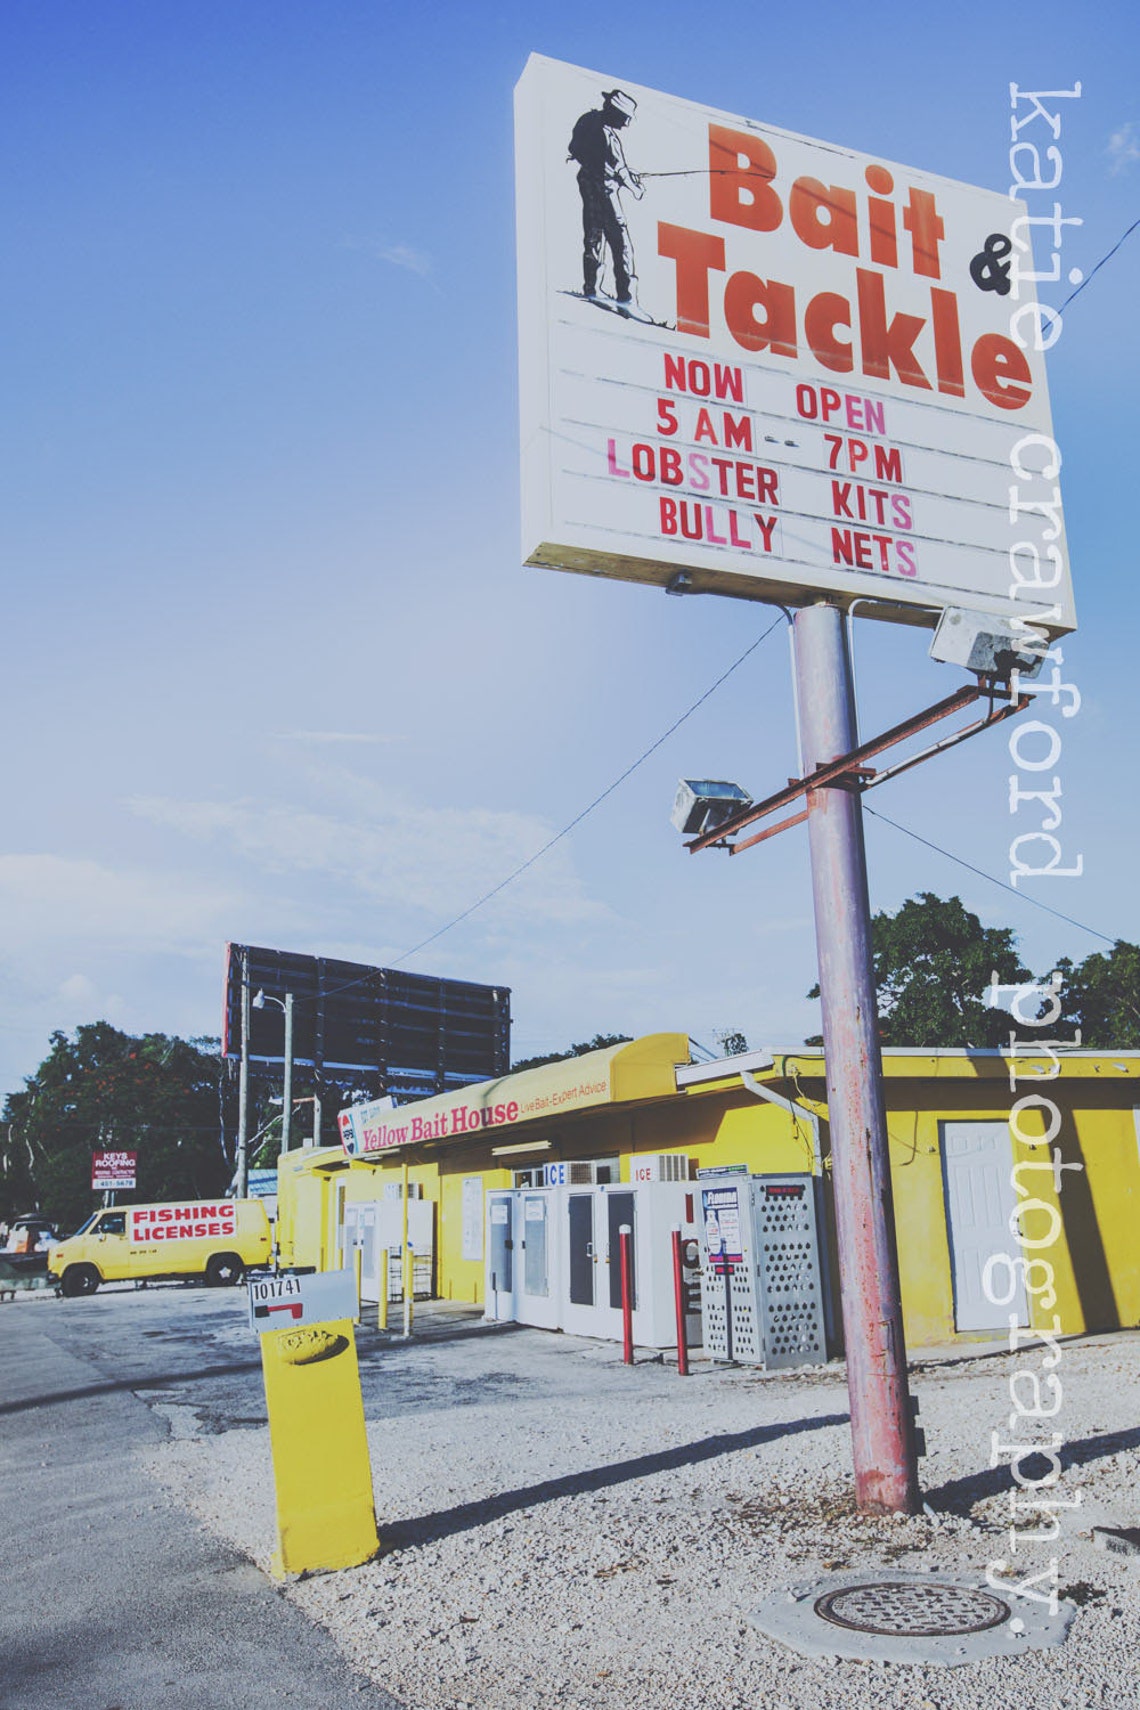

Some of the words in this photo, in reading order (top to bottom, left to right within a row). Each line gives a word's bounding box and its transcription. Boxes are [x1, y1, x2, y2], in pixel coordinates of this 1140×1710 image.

[708, 123, 944, 279] Bait
[970, 233, 1012, 295] &
[657, 222, 1033, 410] Tackle
[664, 353, 744, 403] NOW
[796, 384, 886, 435] OPEN
[656, 398, 678, 436] 5
[694, 407, 753, 452] AM
[824, 433, 902, 483] 7PM
[607, 438, 779, 506] LOBSTER
[831, 480, 912, 530] KITS
[659, 496, 778, 552] BULLY
[831, 527, 916, 577] NETS
[362, 1124, 409, 1151] Yellow
[411, 1111, 449, 1141] Bait
[450, 1100, 519, 1134] House
[103, 1152, 128, 1160] KEYS
[544, 1164, 565, 1185] ICE
[635, 1168, 651, 1182] ICE
[133, 1205, 234, 1224] FISHING
[133, 1222, 234, 1242] LICENSES
[253, 1278, 301, 1300] 101741
